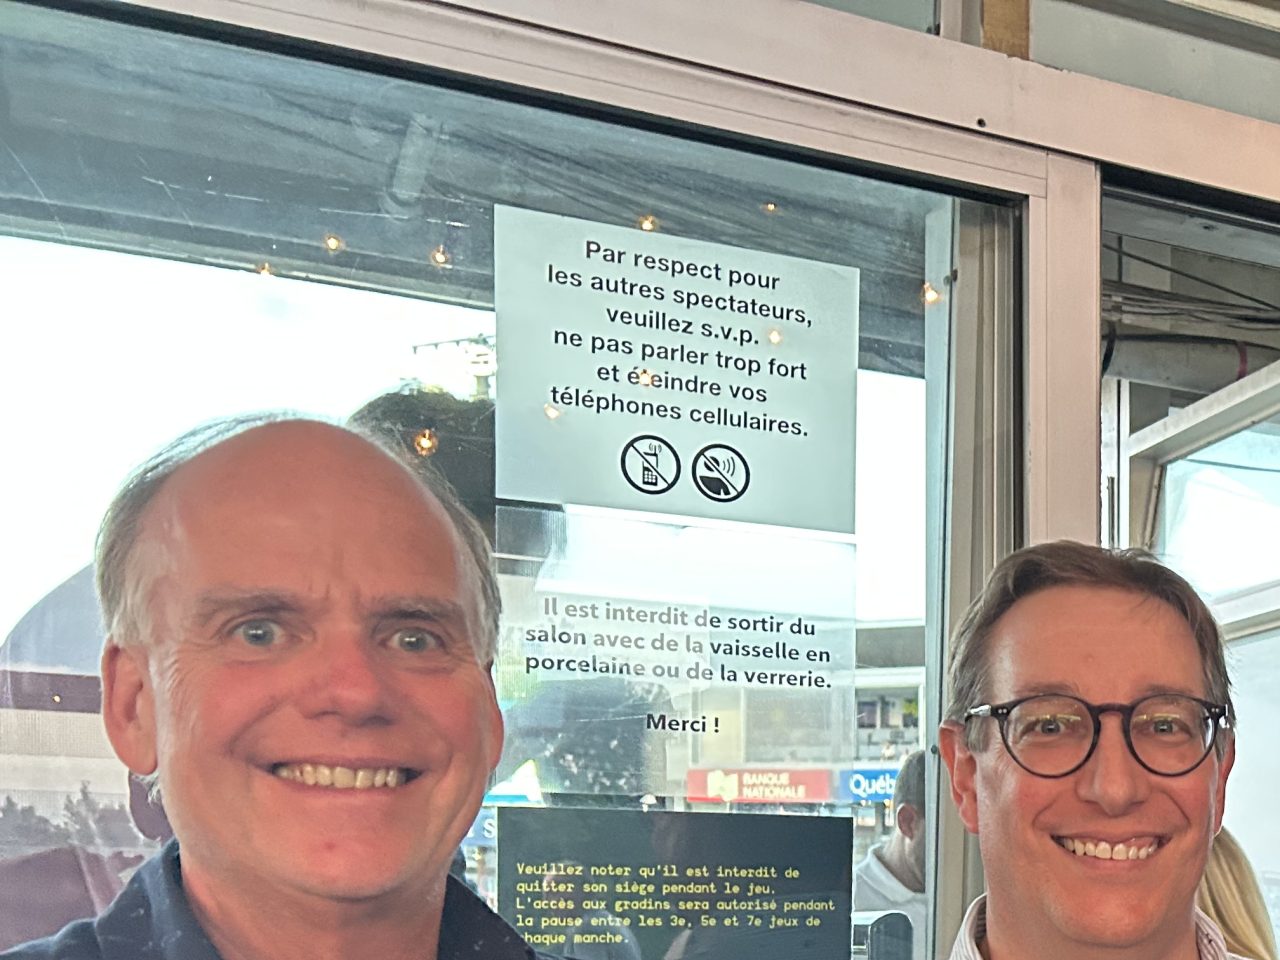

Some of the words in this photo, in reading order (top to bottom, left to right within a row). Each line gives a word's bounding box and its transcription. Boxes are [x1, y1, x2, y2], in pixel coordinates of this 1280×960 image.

[586, 240, 626, 264] Par
[634, 253, 721, 281] respect
[729, 269, 780, 290] pour
[548, 264, 582, 287] les
[591, 276, 665, 301] autres
[673, 289, 812, 328] spectateurs,
[606, 307, 694, 335] veuillez
[701, 322, 759, 347] s.v.p.
[554, 330, 583, 347] ne
[591, 336, 633, 354] pas
[641, 343, 709, 365] parler
[715, 350, 761, 376] trop
[767, 358, 807, 380] fort
[597, 365, 620, 382] et
[627, 366, 721, 396] éeindre
[729, 384, 767, 402] vos
[550, 386, 682, 420] téléphones
[690, 407, 808, 436] cellulaires.
[544, 597, 558, 616] Il
[565, 603, 599, 619] est
[605, 602, 688, 626] interdit
[695, 609, 721, 628] de
[728, 616, 783, 633] sortir
[789, 617, 815, 636] du
[525, 625, 586, 645] salon
[593, 633, 645, 649] avec
[651, 633, 679, 651] de
[686, 635, 703, 653] la
[710, 639, 799, 660] vaisselle
[806, 650, 830, 662] en
[525, 655, 646, 676] porcelaine
[652, 664, 679, 678] ou
[686, 662, 713, 680] de
[721, 664, 737, 682] la
[744, 670, 831, 688] verrerie.
[646, 713, 706, 732] Merci
[714, 717, 719, 733] !
[743, 773, 790, 785] BANQUE
[743, 785, 805, 799] NATIONALE
[850, 773, 896, 798] Québ
[517, 863, 583, 875] Veuillez
[591, 864, 631, 875] noter
[639, 865, 678, 878] qu'il
[686, 865, 709, 877] est
[717, 866, 778, 878] interdit
[785, 867, 800, 878] de
[516, 880, 575, 894] quitter
[583, 883, 607, 893] son
[616, 881, 655, 895] siège
[662, 882, 717, 895] pendant
[724, 883, 740, 894] le
[747, 883, 775, 896] jeu.
[516, 897, 574, 909] L'accès
[583, 901, 606, 909] aux
[615, 898, 670, 912] gradins
[678, 901, 709, 910] sera
[717, 899, 777, 910] autorisé
[784, 900, 835, 912] pendant
[516, 915, 533, 926] la
[541, 917, 583, 929] pause
[591, 915, 631, 926] entre
[638, 915, 662, 926] les
[670, 915, 692, 928] 3e,
[701, 915, 716, 926] 5e
[724, 916, 739, 926] et
[747, 915, 762, 926] 7e
[769, 915, 798, 929] jeux
[806, 916, 821, 926] de
[574, 932, 629, 943] manche.
